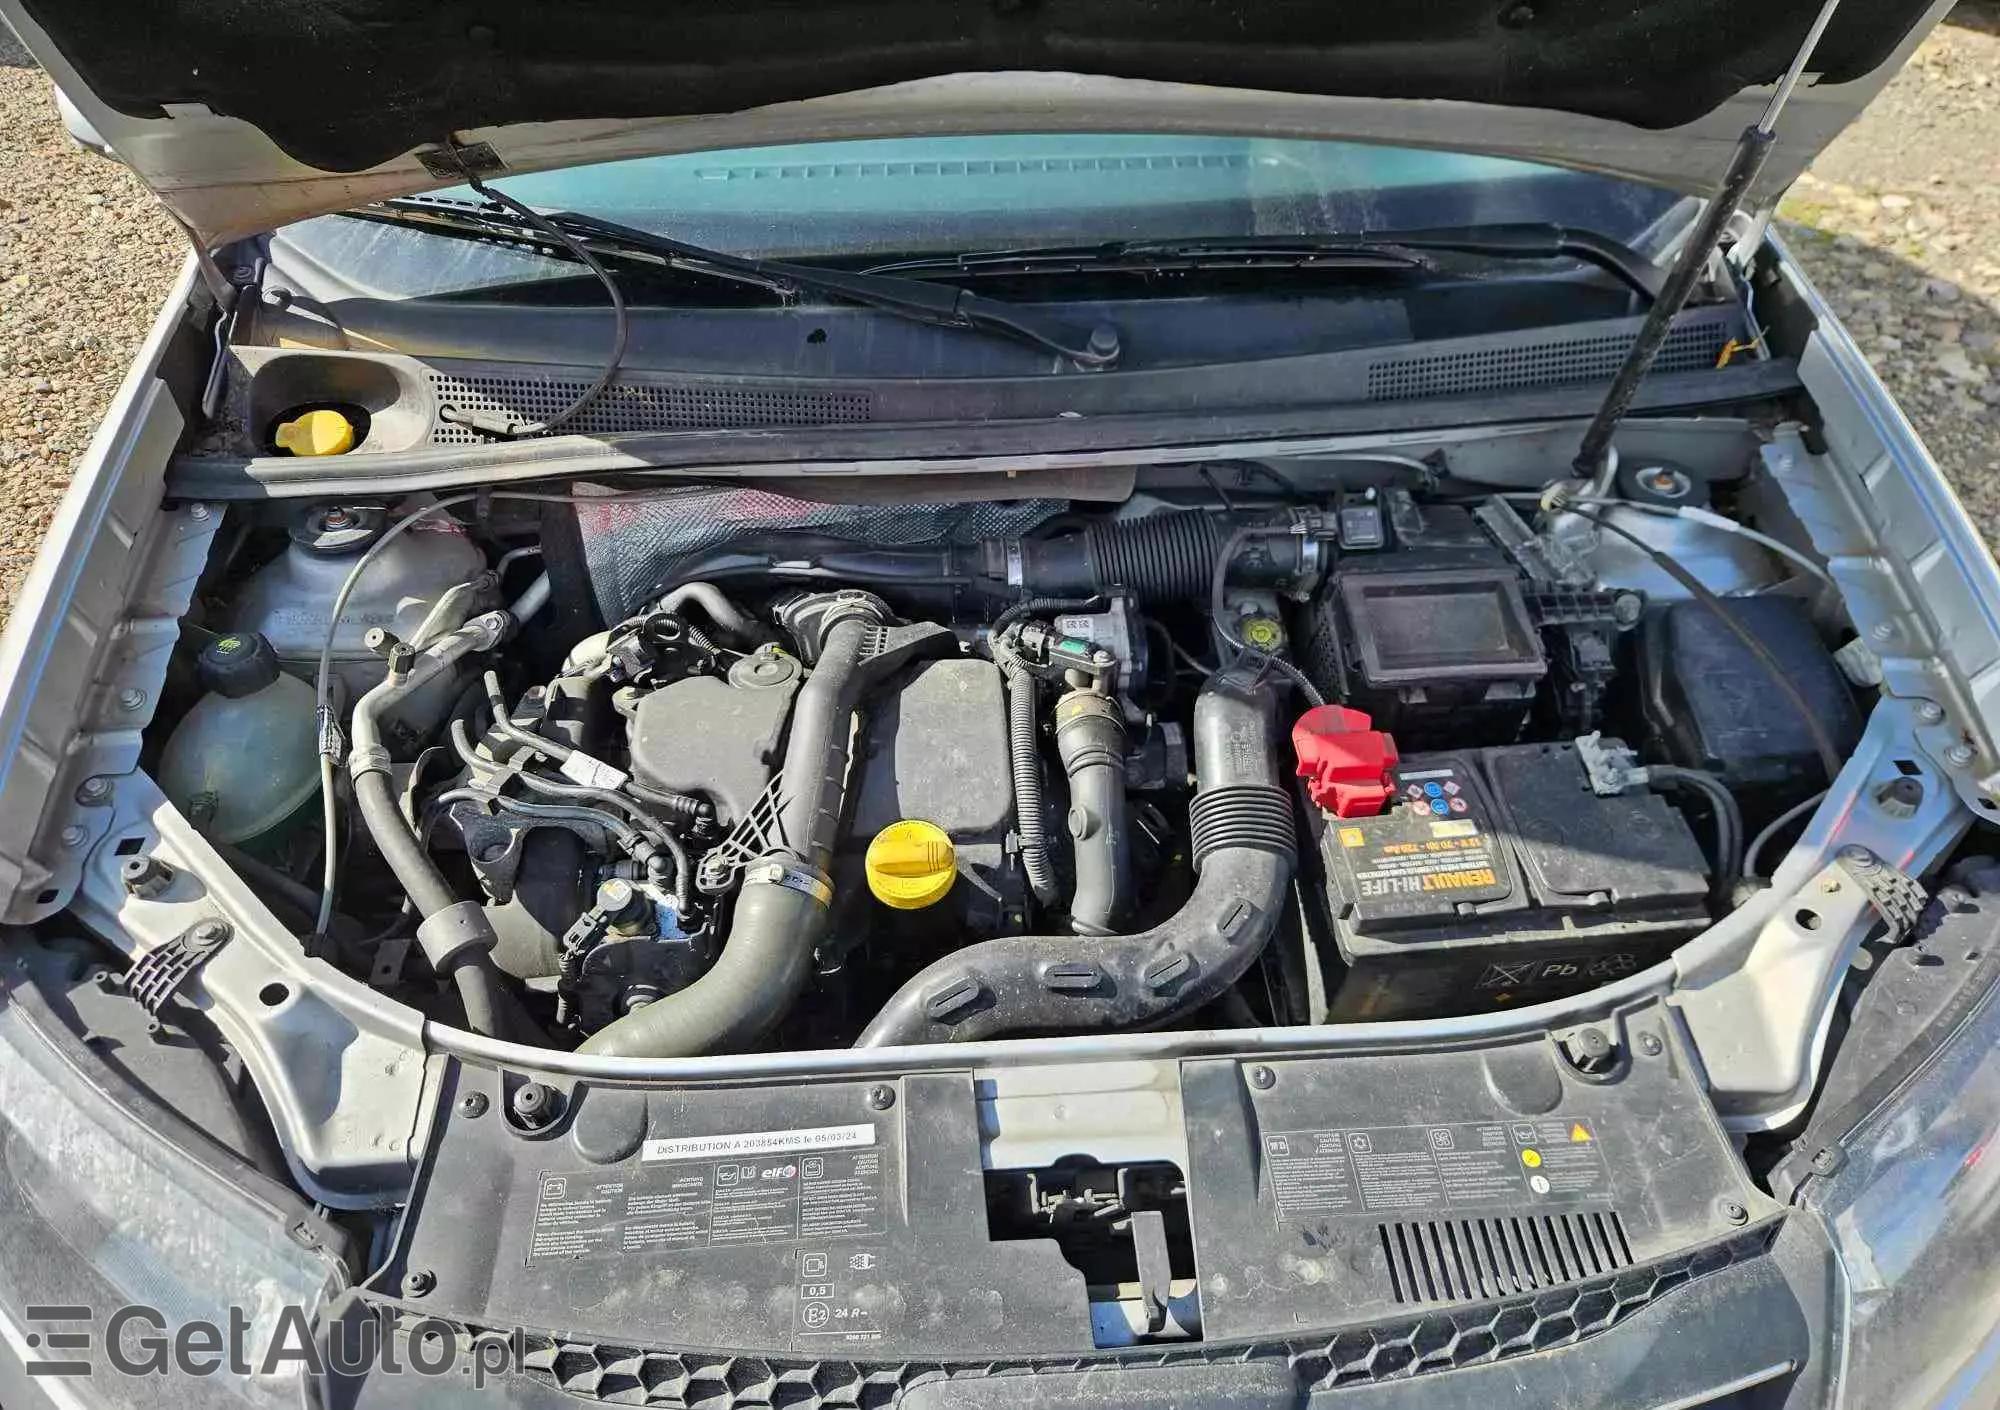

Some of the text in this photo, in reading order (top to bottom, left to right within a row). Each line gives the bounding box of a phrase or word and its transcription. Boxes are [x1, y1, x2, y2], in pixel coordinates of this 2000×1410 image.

[1423, 868, 1497, 891] RENAULT
[1542, 963, 1577, 977] Pb
[656, 1141, 731, 1155] DISTRIBUTION
[809, 1286, 826, 1297] 0,5
